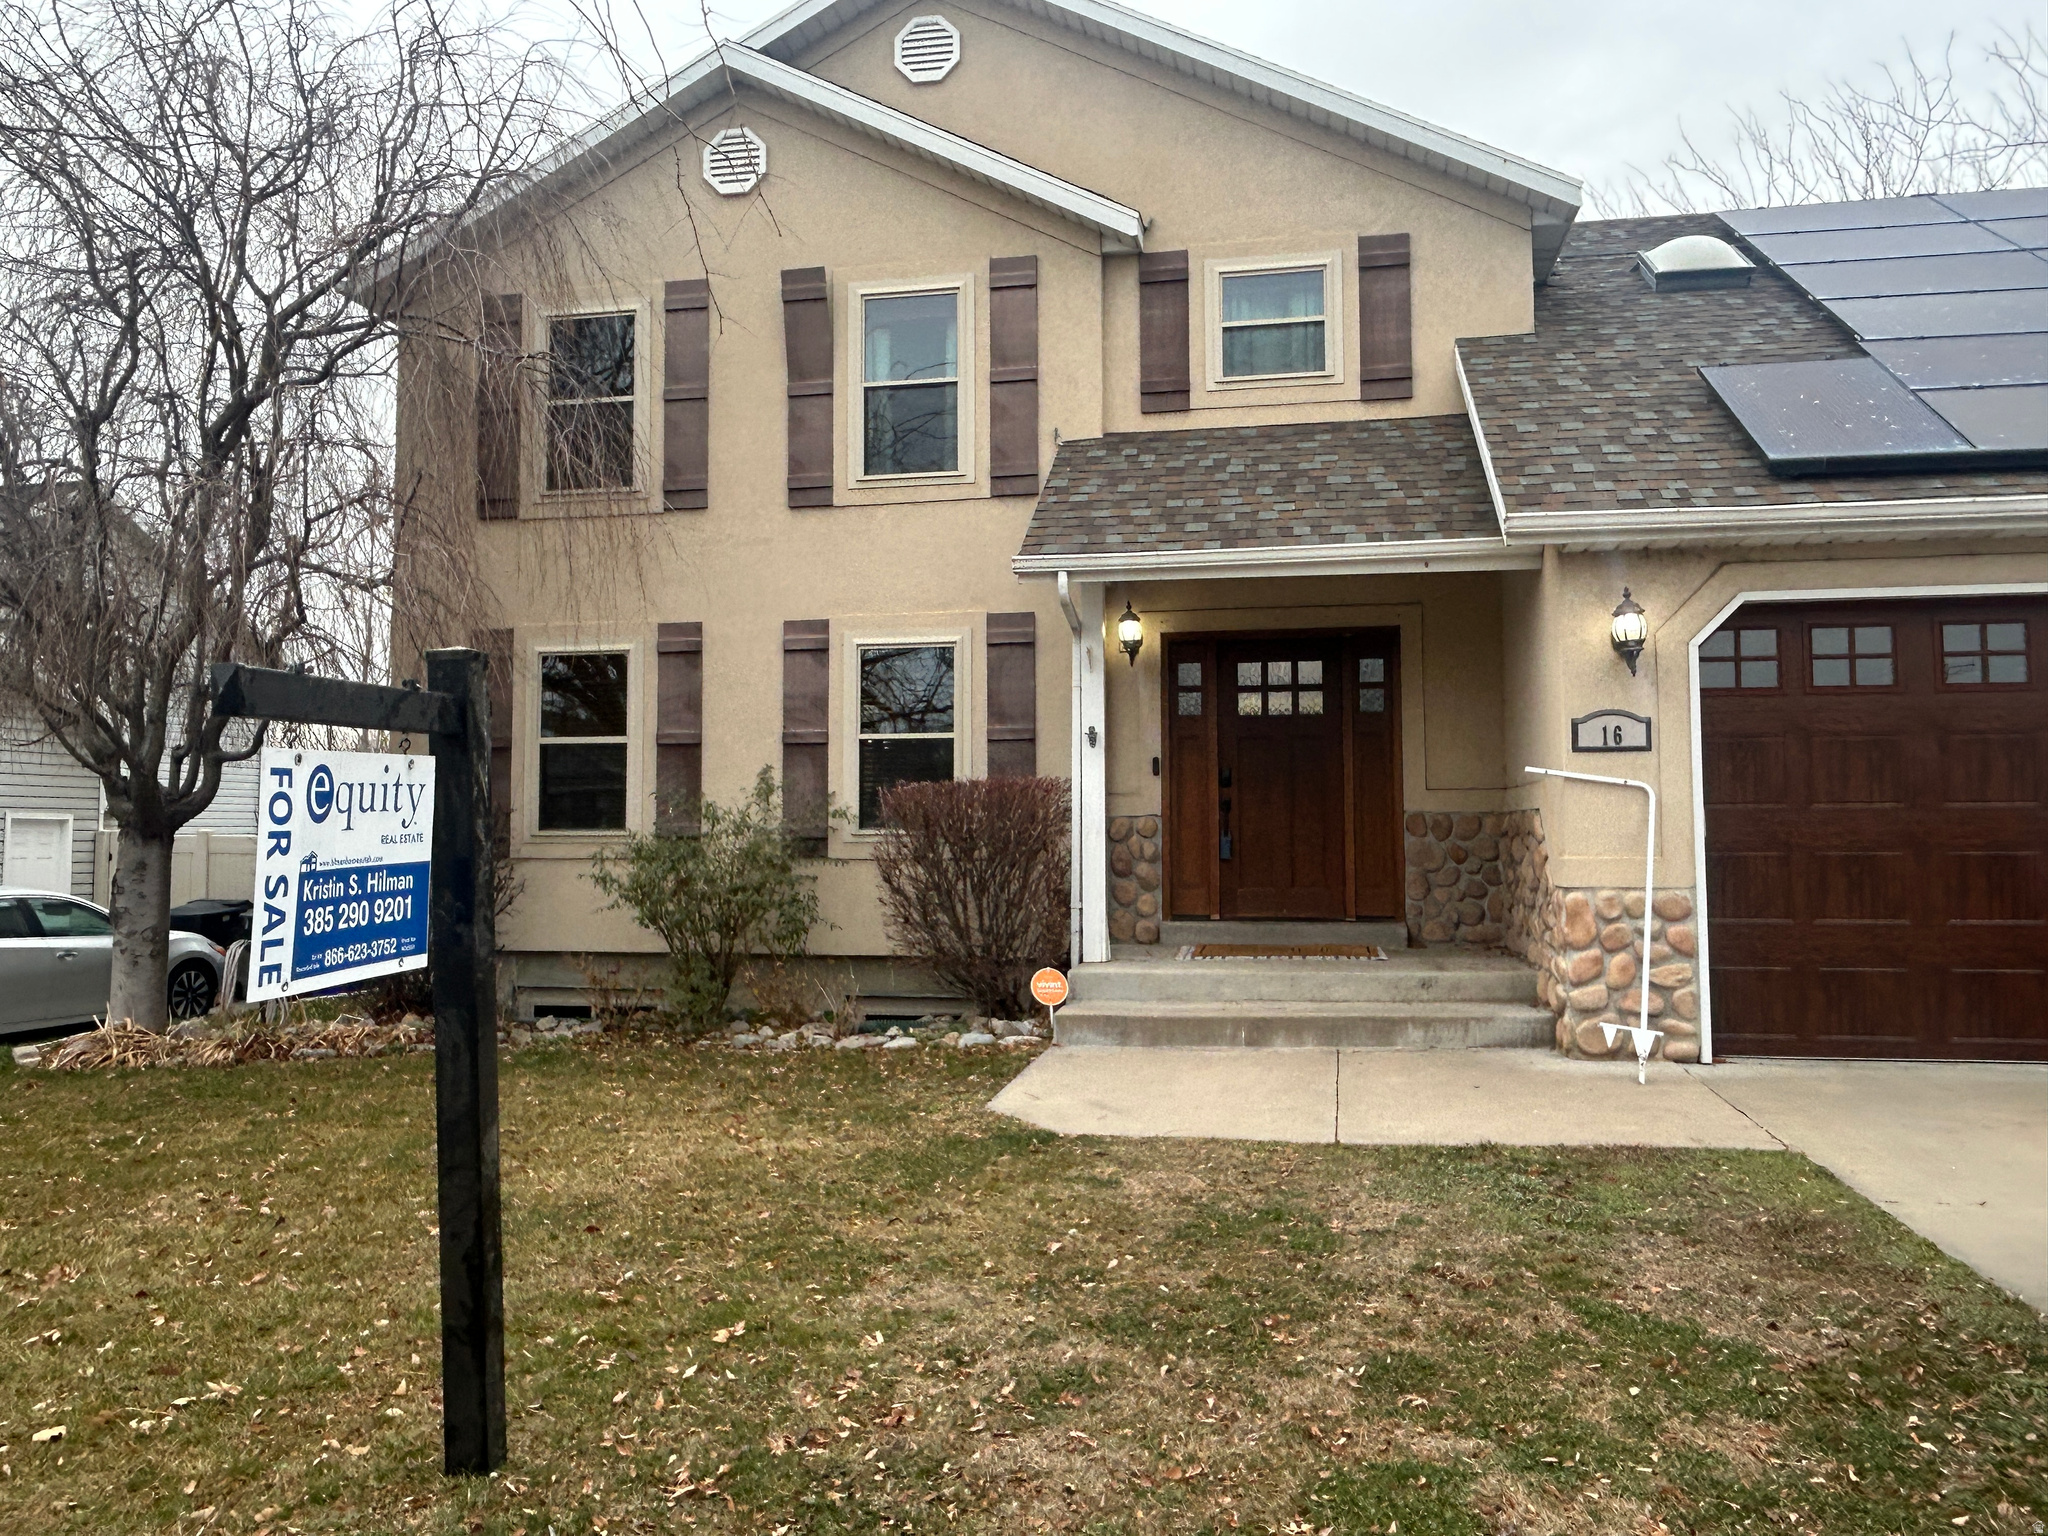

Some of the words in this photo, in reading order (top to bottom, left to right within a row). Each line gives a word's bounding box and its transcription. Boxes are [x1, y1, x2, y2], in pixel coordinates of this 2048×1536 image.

[1602, 725, 1623, 746] 16
[266, 767, 293, 861] FOR
[306, 763, 426, 831] equity
[381, 834, 398, 844] REAL
[400, 833, 424, 844] ESTATE
[303, 876, 344, 902] Kristin
[349, 873, 362, 895] S.
[367, 871, 413, 894] Hilman
[258, 874, 290, 988] SALE
[303, 905, 334, 936] 385
[338, 900, 370, 930] 290
[374, 894, 412, 925] 9201
[324, 937, 397, 968] 866-623-3752
